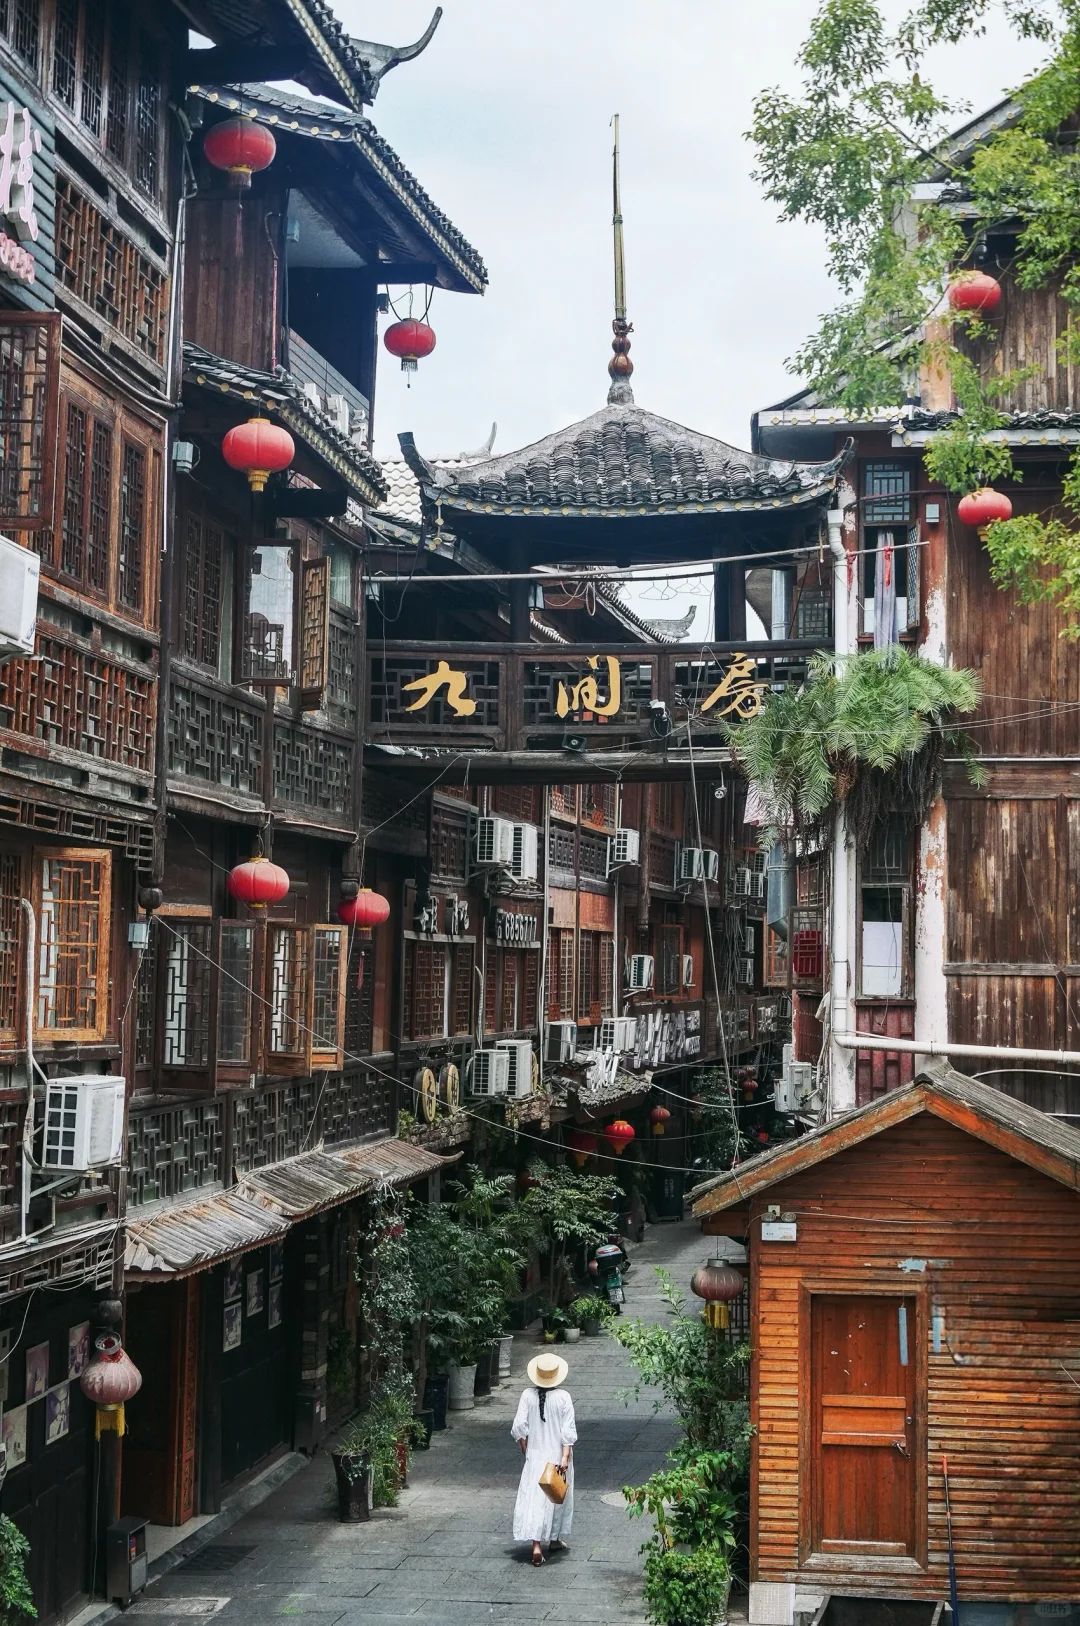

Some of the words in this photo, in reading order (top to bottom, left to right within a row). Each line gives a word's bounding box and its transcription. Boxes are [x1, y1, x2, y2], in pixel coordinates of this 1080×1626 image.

[401, 652, 770, 718] 九间房
[505, 912, 538, 942] 6856777
